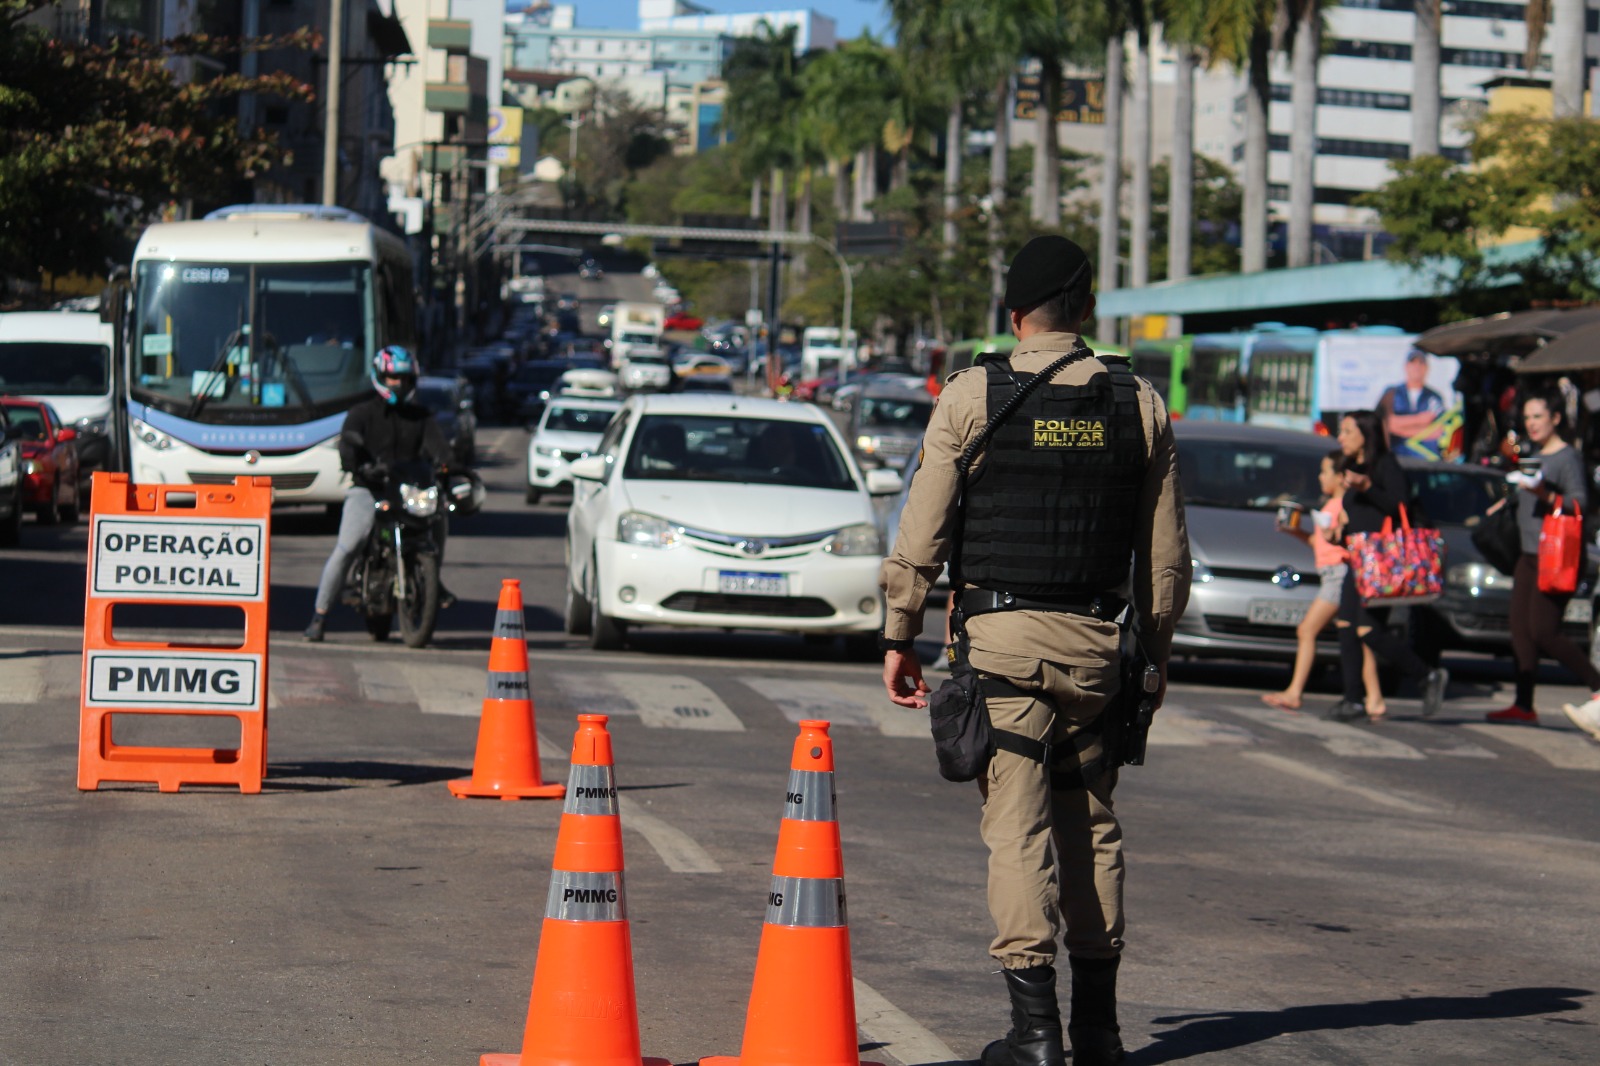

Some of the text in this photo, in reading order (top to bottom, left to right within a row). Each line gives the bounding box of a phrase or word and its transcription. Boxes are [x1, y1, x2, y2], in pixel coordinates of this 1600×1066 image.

[1034, 432, 1103, 441] MILITAR
[105, 533, 253, 558] OPERAÇÃO
[115, 565, 240, 587] POLICIAL
[108, 666, 240, 694] PMMG
[575, 787, 617, 799] PMMG
[563, 888, 617, 903] PMMG
